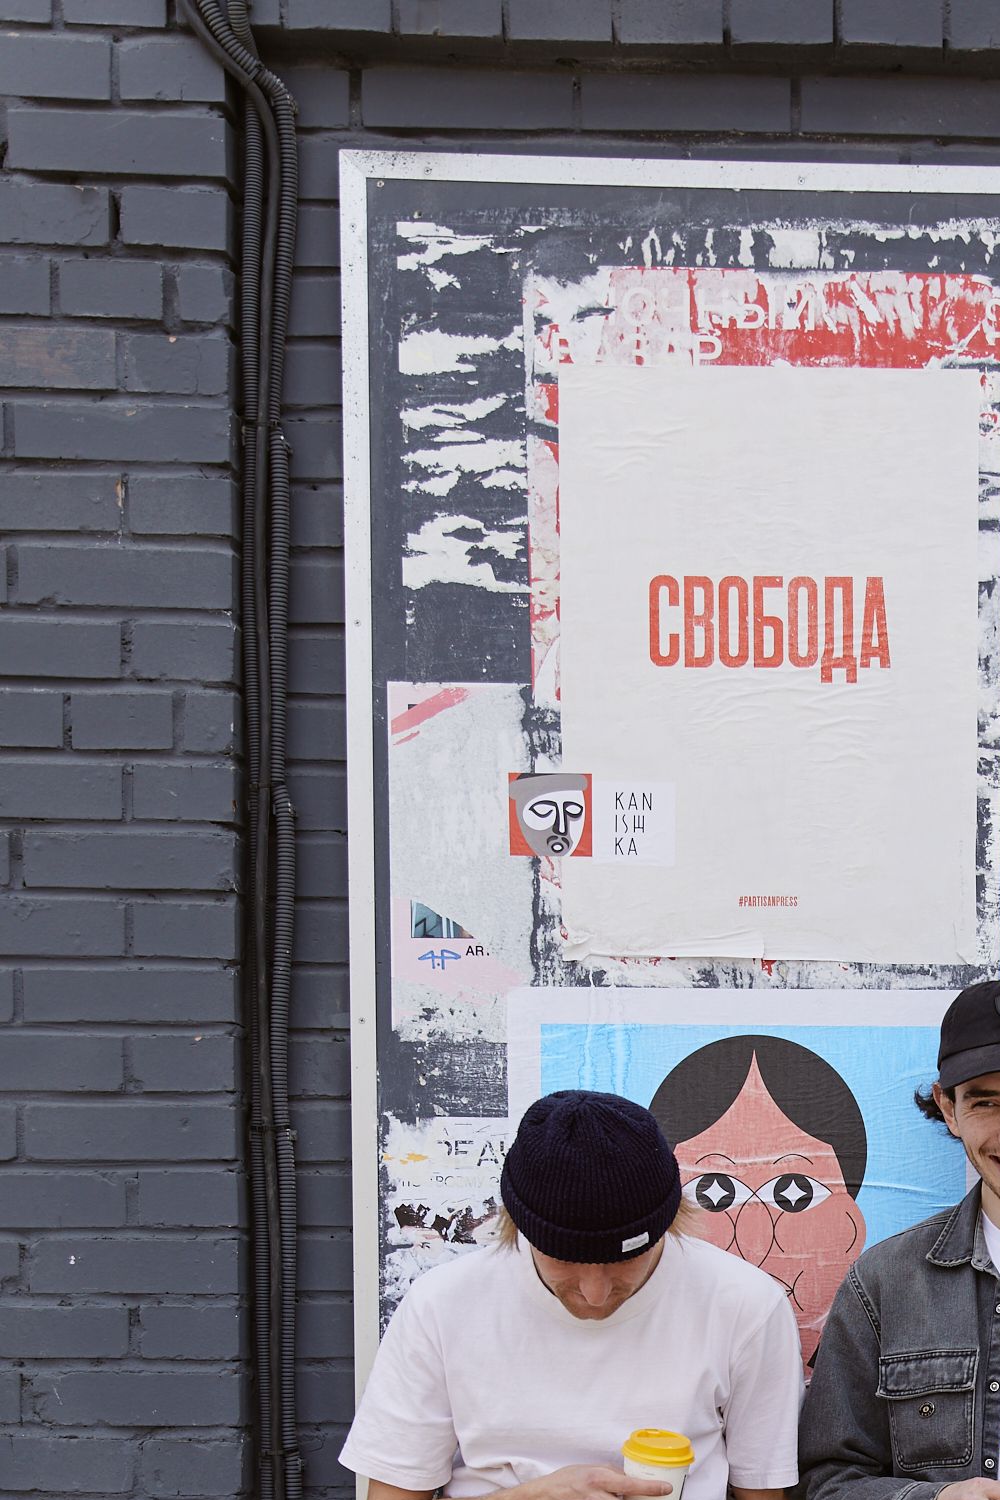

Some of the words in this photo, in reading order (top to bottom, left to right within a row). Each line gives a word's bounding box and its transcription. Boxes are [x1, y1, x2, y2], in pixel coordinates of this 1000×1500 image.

[649, 575, 891, 683] СВОБОДА
[615, 792, 652, 811] KAN
[615, 837, 638, 856] KA
[738, 896, 798, 907] #PARTISANPRESS
